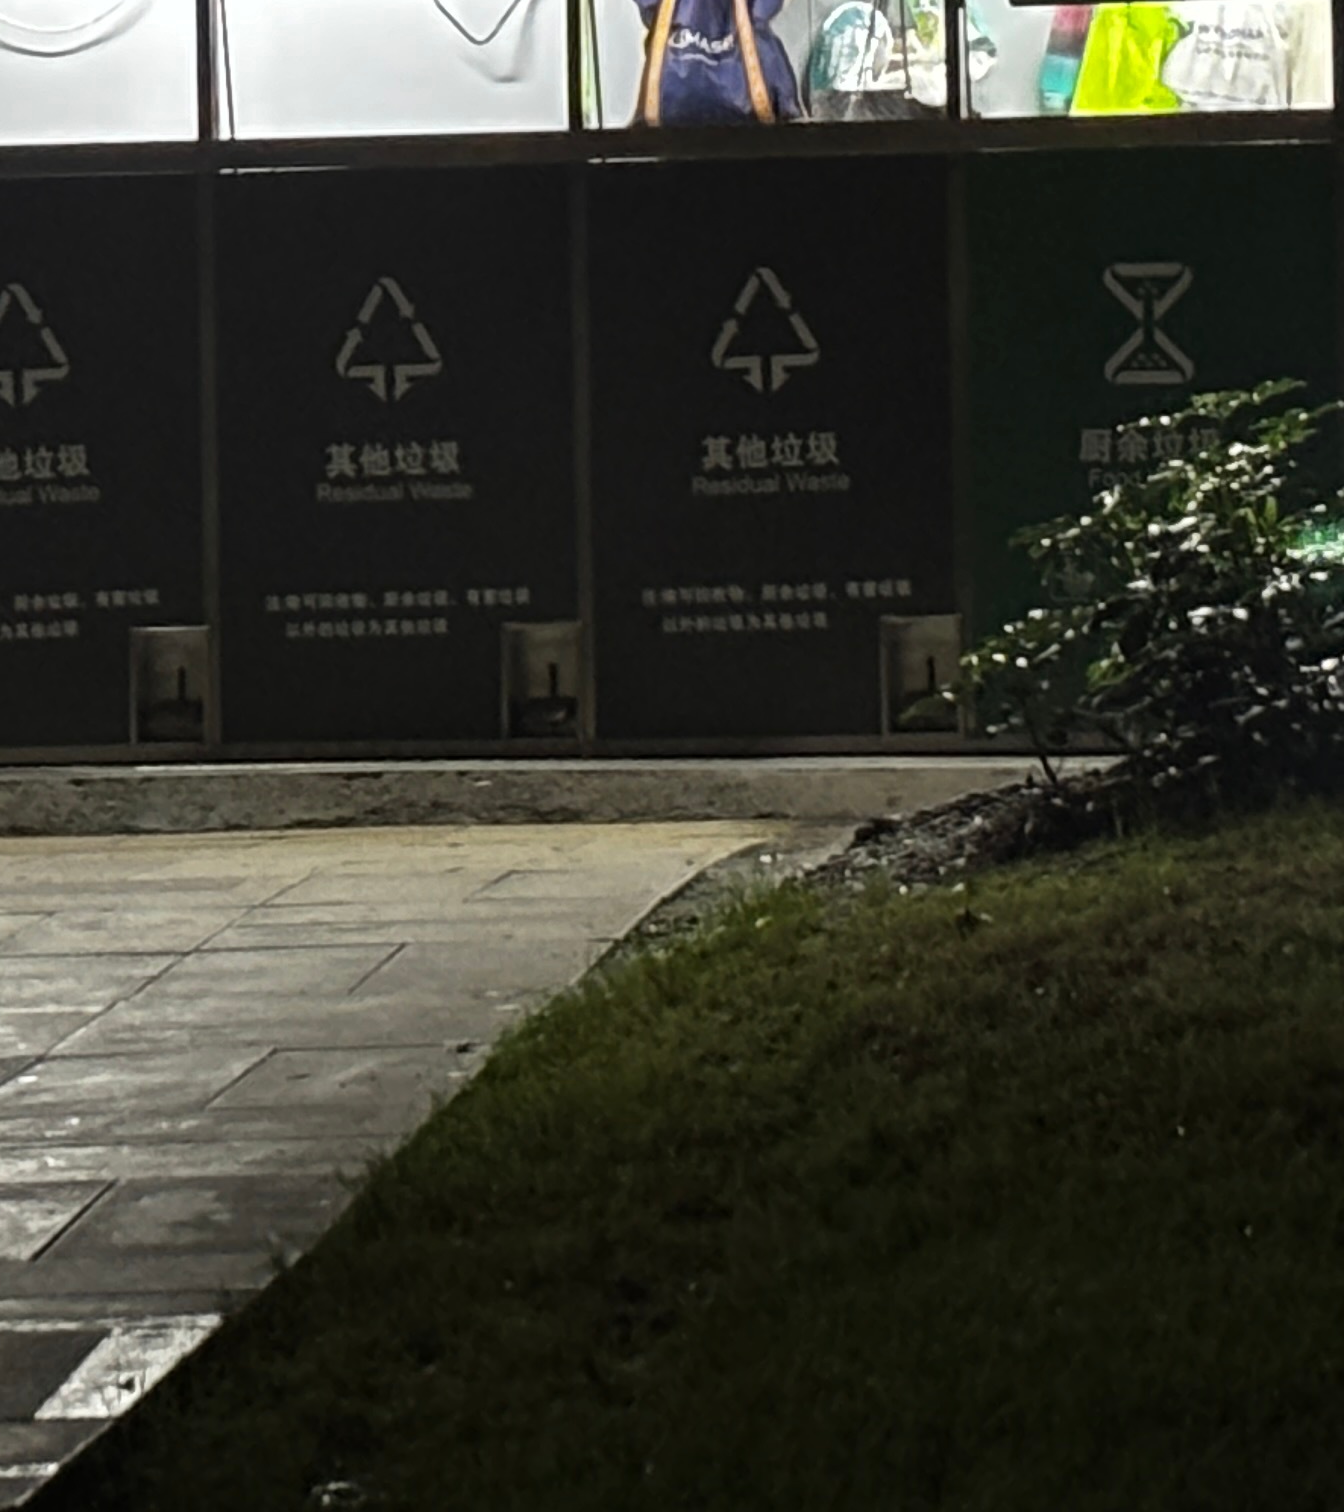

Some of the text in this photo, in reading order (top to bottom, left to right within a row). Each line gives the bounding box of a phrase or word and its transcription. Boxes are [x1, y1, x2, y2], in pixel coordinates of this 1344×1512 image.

[325, 440, 461, 479] 其他垃圾
[701, 430, 840, 470] 其他垃圾
[691, 472, 851, 496] Residual Waste
